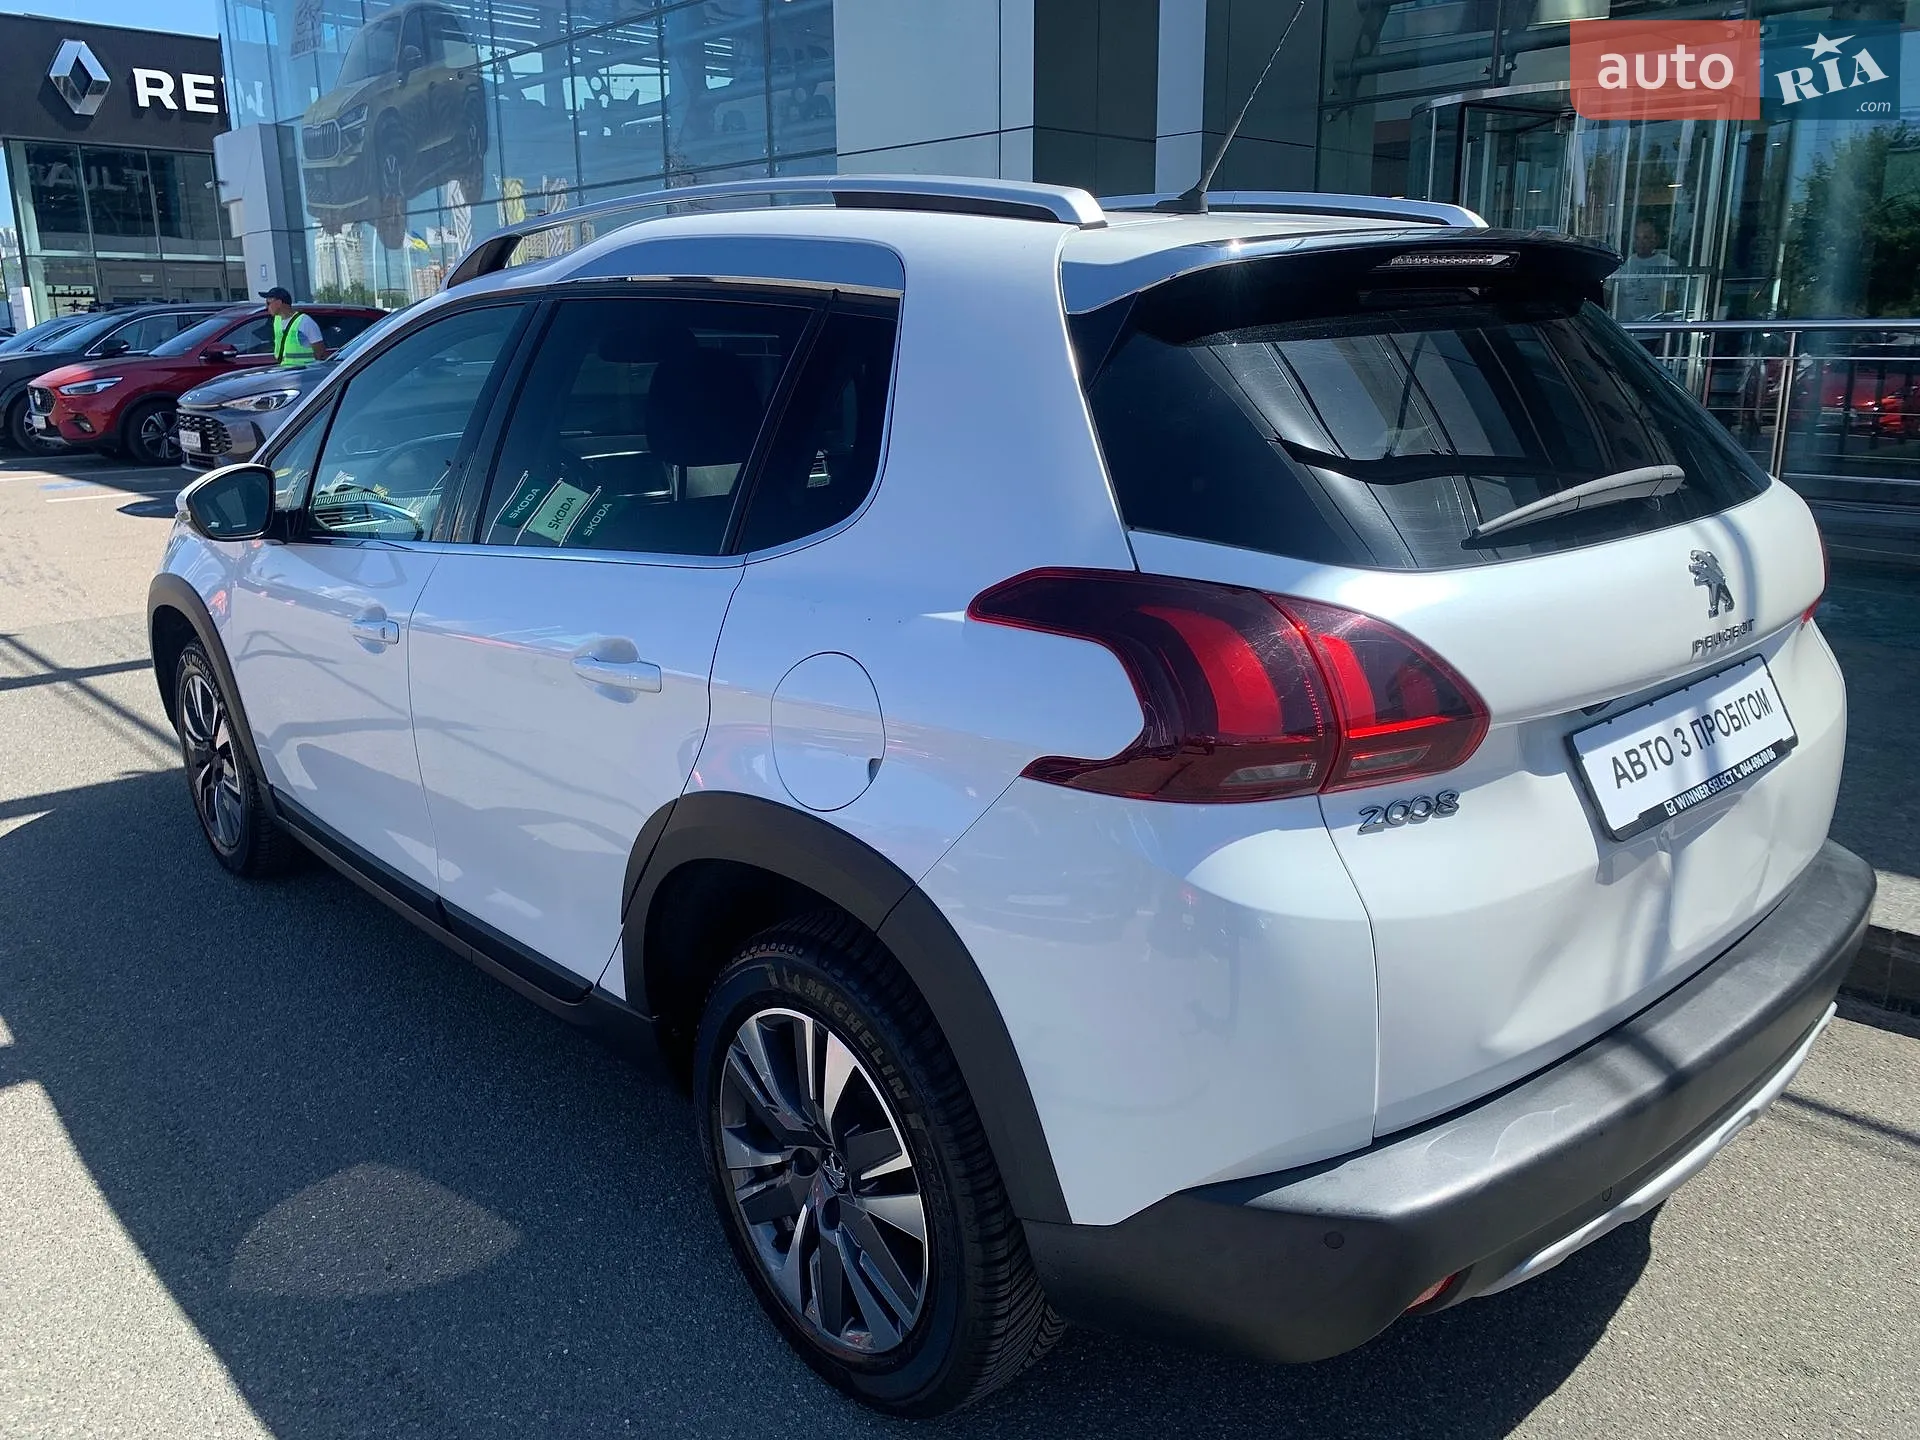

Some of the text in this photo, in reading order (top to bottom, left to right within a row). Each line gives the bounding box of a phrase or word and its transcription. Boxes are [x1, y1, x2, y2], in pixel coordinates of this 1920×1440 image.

[1692, 619, 1755, 652] PEUGEOT
[1610, 735, 1674, 789] АВТО
[1689, 687, 1773, 750] ПРОБІГОМ
[1358, 789, 1460, 833] 2008
[1674, 783, 1712, 810] WINNER
[1708, 770, 1735, 794] SELECT
[805, 978, 911, 1100] MICHELIN
